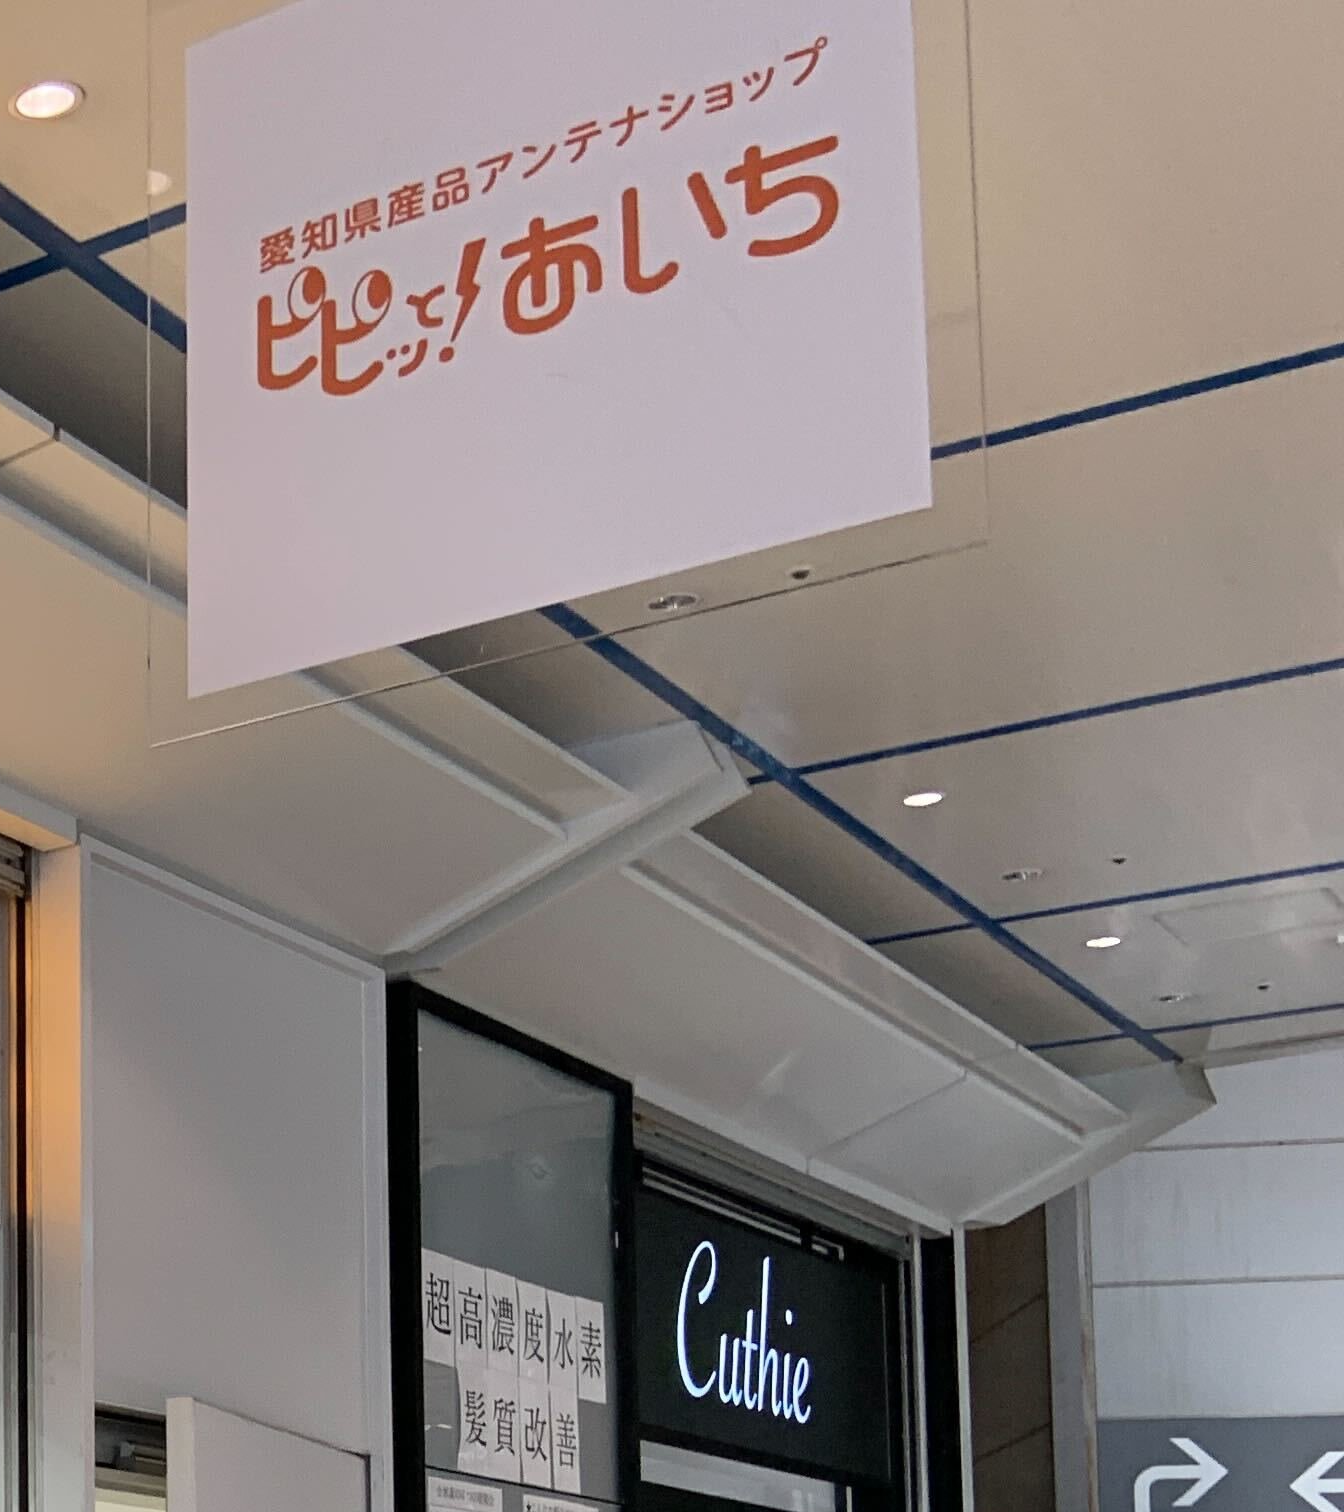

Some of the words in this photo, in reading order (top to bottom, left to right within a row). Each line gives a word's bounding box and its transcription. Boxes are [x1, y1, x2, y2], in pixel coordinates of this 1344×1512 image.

[258, 36, 829, 274] 愛知県産品アンテナショップ
[424, 1271, 604, 1379] 超高濃度水素
[676, 1240, 812, 1424] Cuthie
[463, 1389, 579, 1470] 髪質改善
